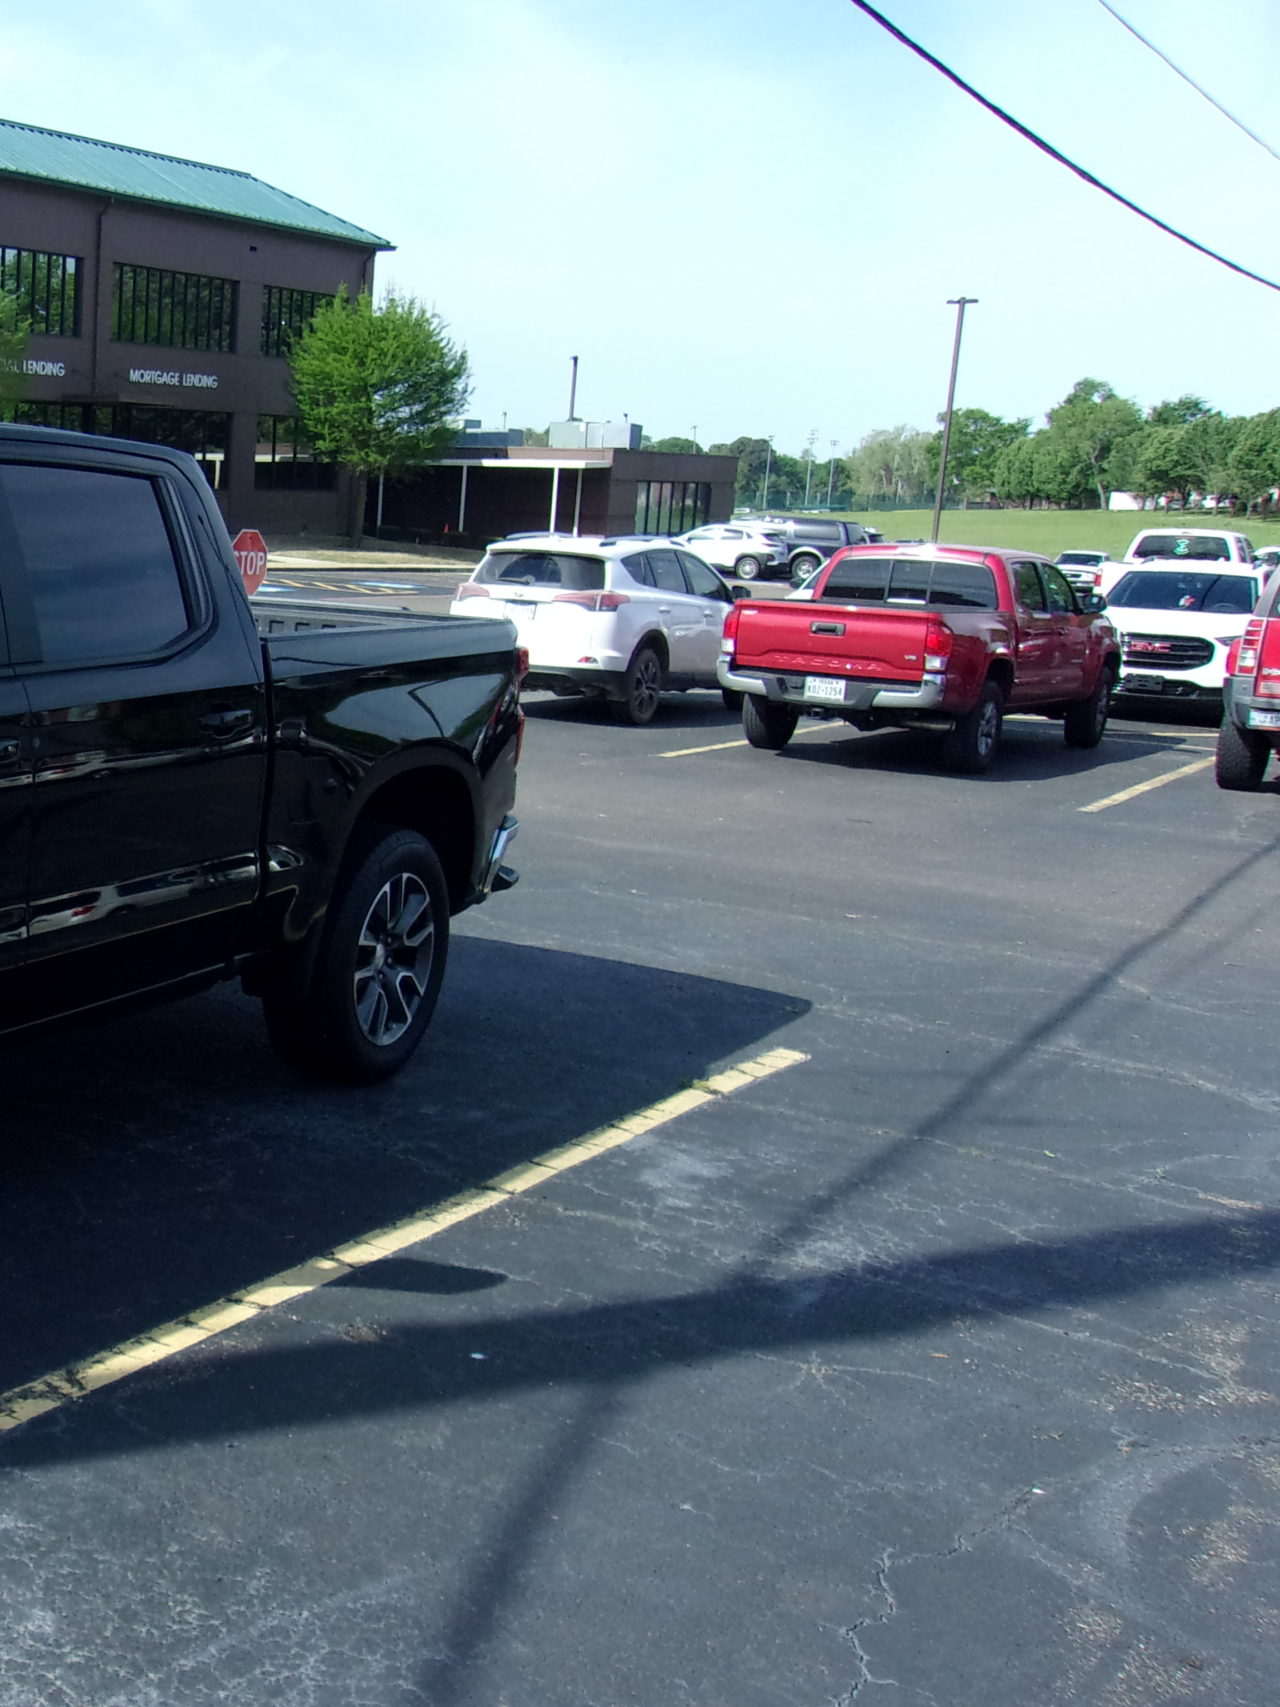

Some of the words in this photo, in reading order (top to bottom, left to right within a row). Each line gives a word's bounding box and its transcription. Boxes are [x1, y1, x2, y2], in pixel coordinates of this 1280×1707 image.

[23, 360, 65, 376] LENDING
[129, 368, 180, 385] MORTGAGE
[182, 373, 218, 388] LENDING
[1131, 641, 1171, 652] GMC
